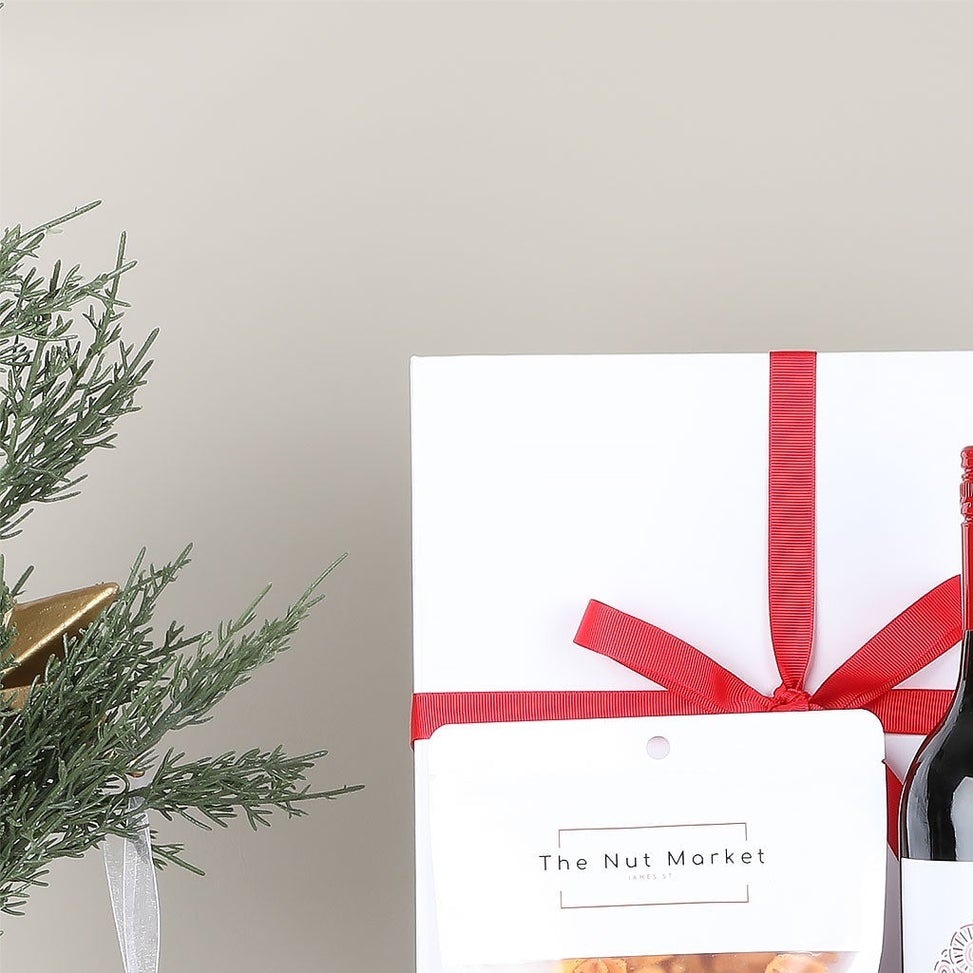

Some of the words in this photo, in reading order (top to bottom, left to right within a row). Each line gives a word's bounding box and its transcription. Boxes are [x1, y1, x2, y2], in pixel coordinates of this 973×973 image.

[539, 854, 588, 871] The
[604, 852, 651, 869] Nut
[667, 848, 765, 867] Market
